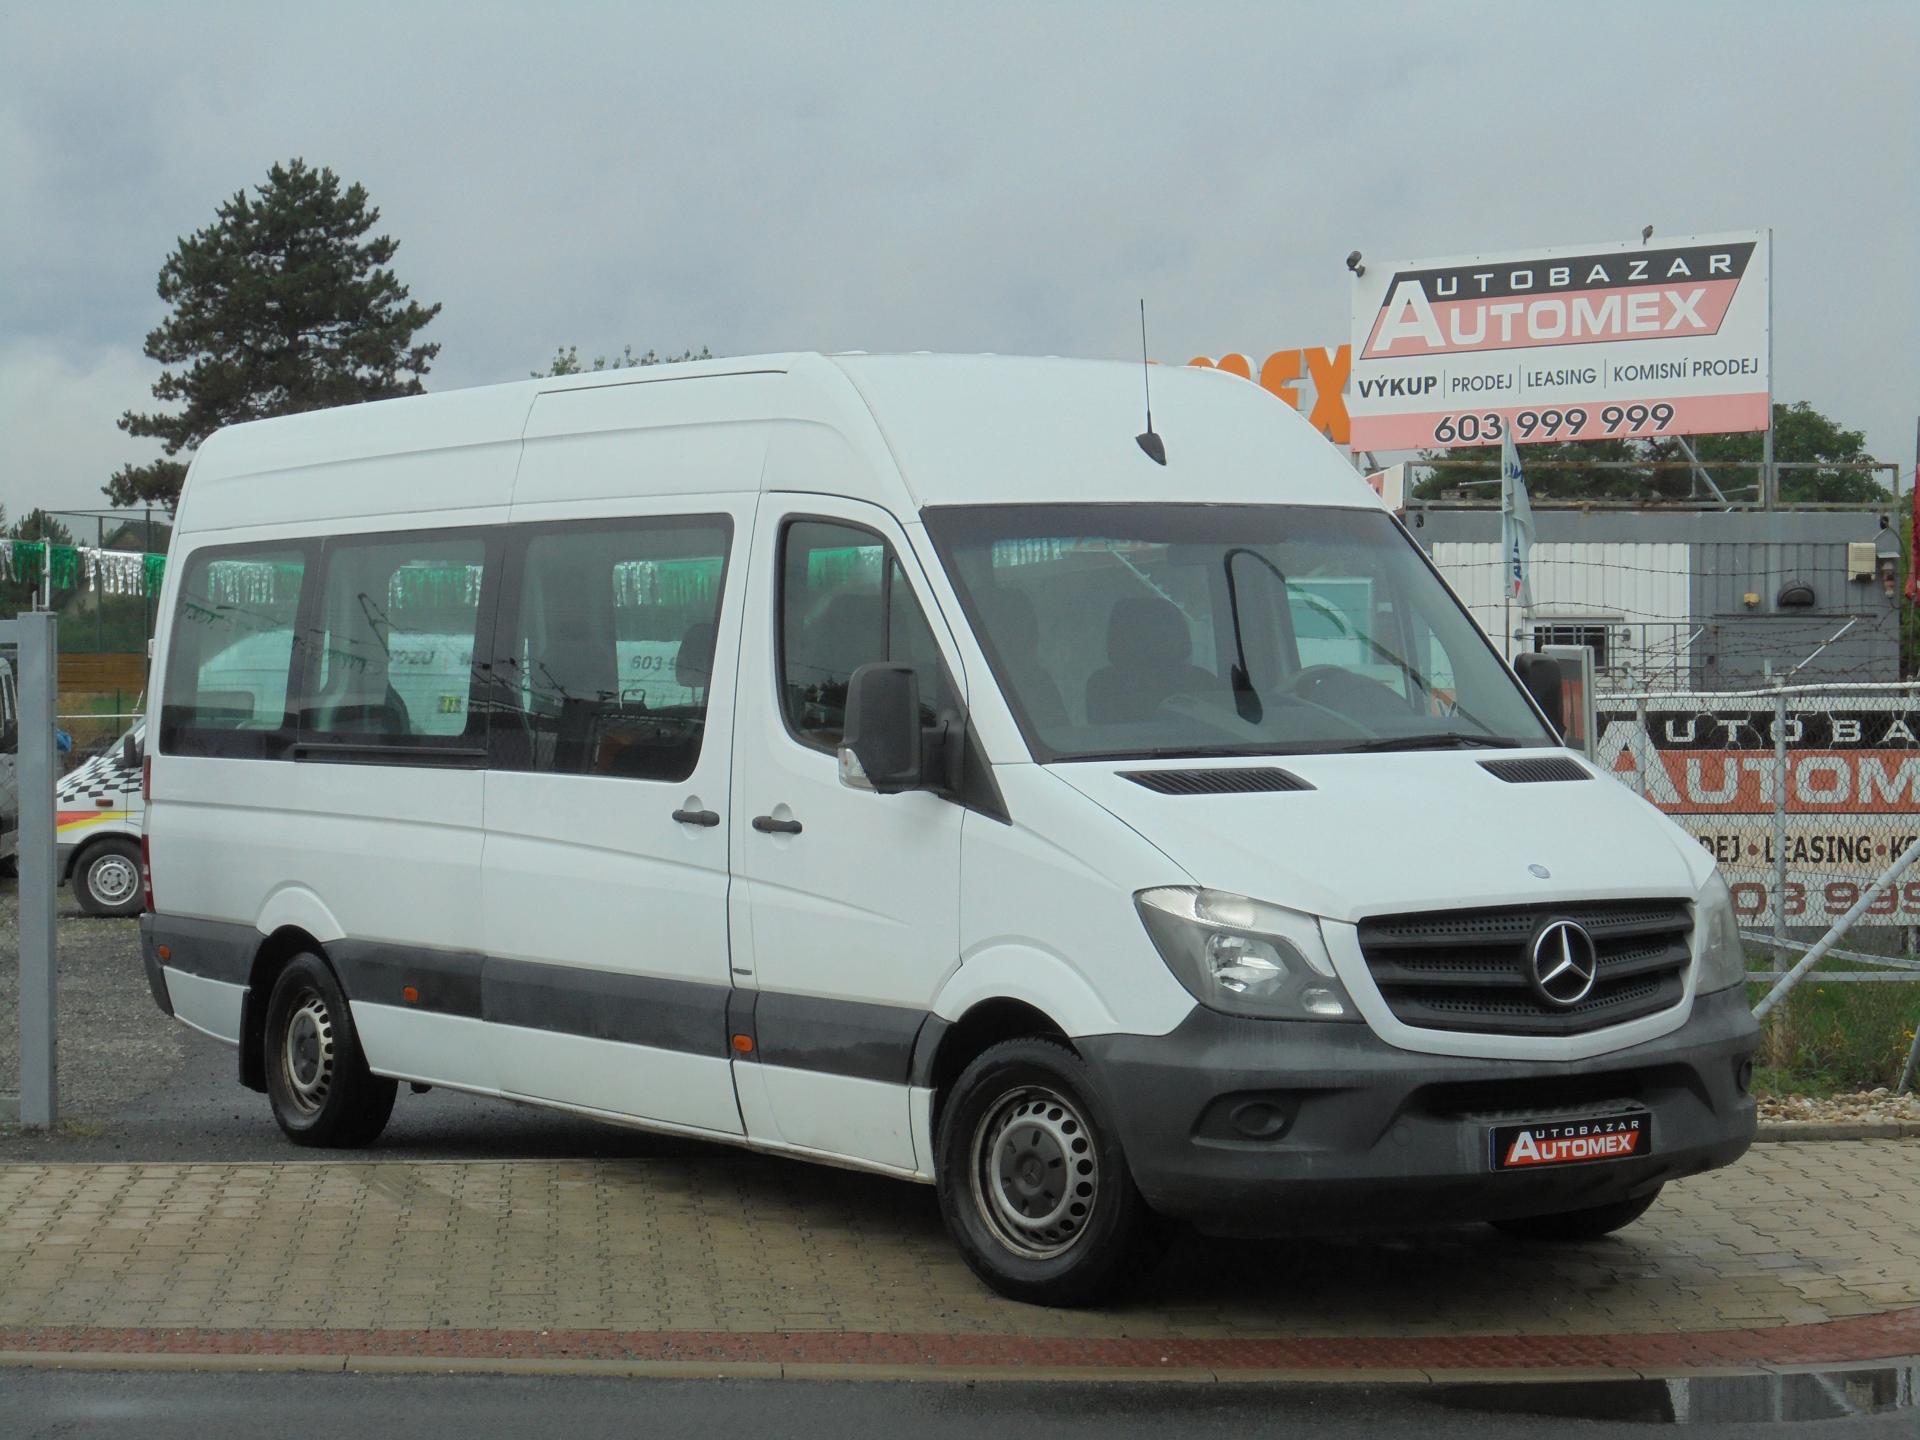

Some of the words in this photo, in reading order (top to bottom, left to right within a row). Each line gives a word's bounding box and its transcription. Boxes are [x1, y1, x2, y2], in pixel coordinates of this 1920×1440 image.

[1372, 279, 1707, 352] AUTOMEX
[1527, 368, 1597, 388] LEASING
[1614, 357, 1688, 382] KOMISNÍ
[1693, 358, 1758, 377] PRODEJ
[1358, 374, 1438, 398] VÝKUP
[1452, 373, 1513, 393] PRODEJ
[1434, 413, 1503, 442] 603
[1516, 409, 1588, 438] 999
[1601, 403, 1674, 432] 999
[1510, 1131, 1632, 1163] AUTOMEX
